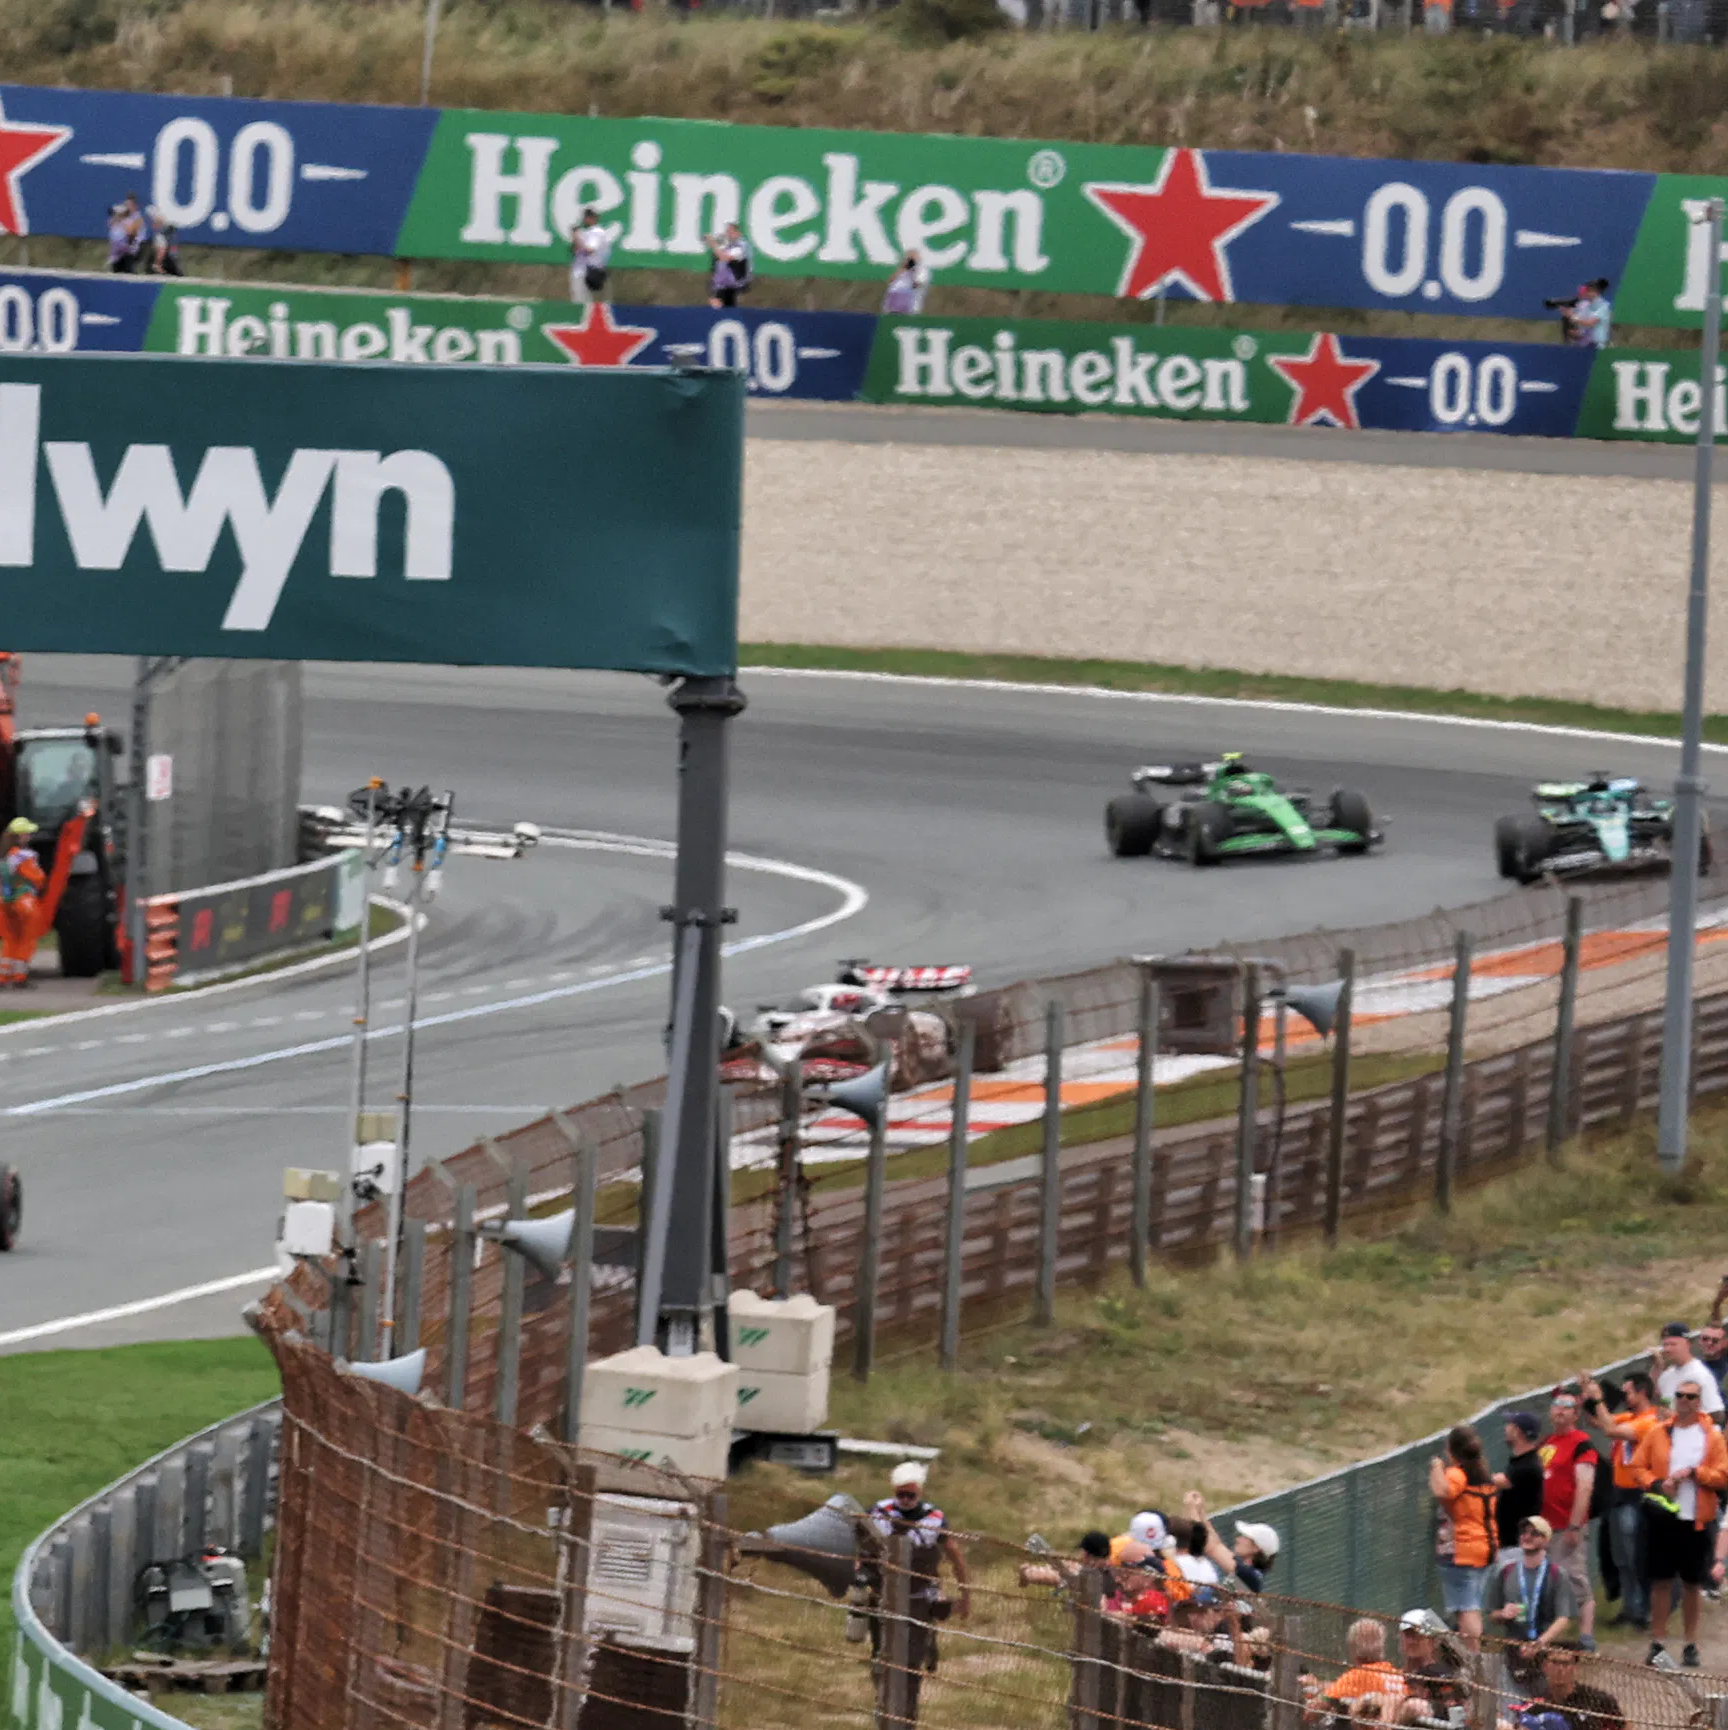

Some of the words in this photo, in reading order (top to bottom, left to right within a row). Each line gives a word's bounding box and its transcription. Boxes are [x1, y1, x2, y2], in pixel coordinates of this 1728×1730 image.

[151, 116, 294, 232] 0.0
[461, 131, 1049, 274] Heineken
[1361, 182, 1508, 302] 0.0
[175, 295, 522, 363] Heineken
[893, 327, 1249, 414] Heineken
[1429, 352, 1519, 428] 0.0
